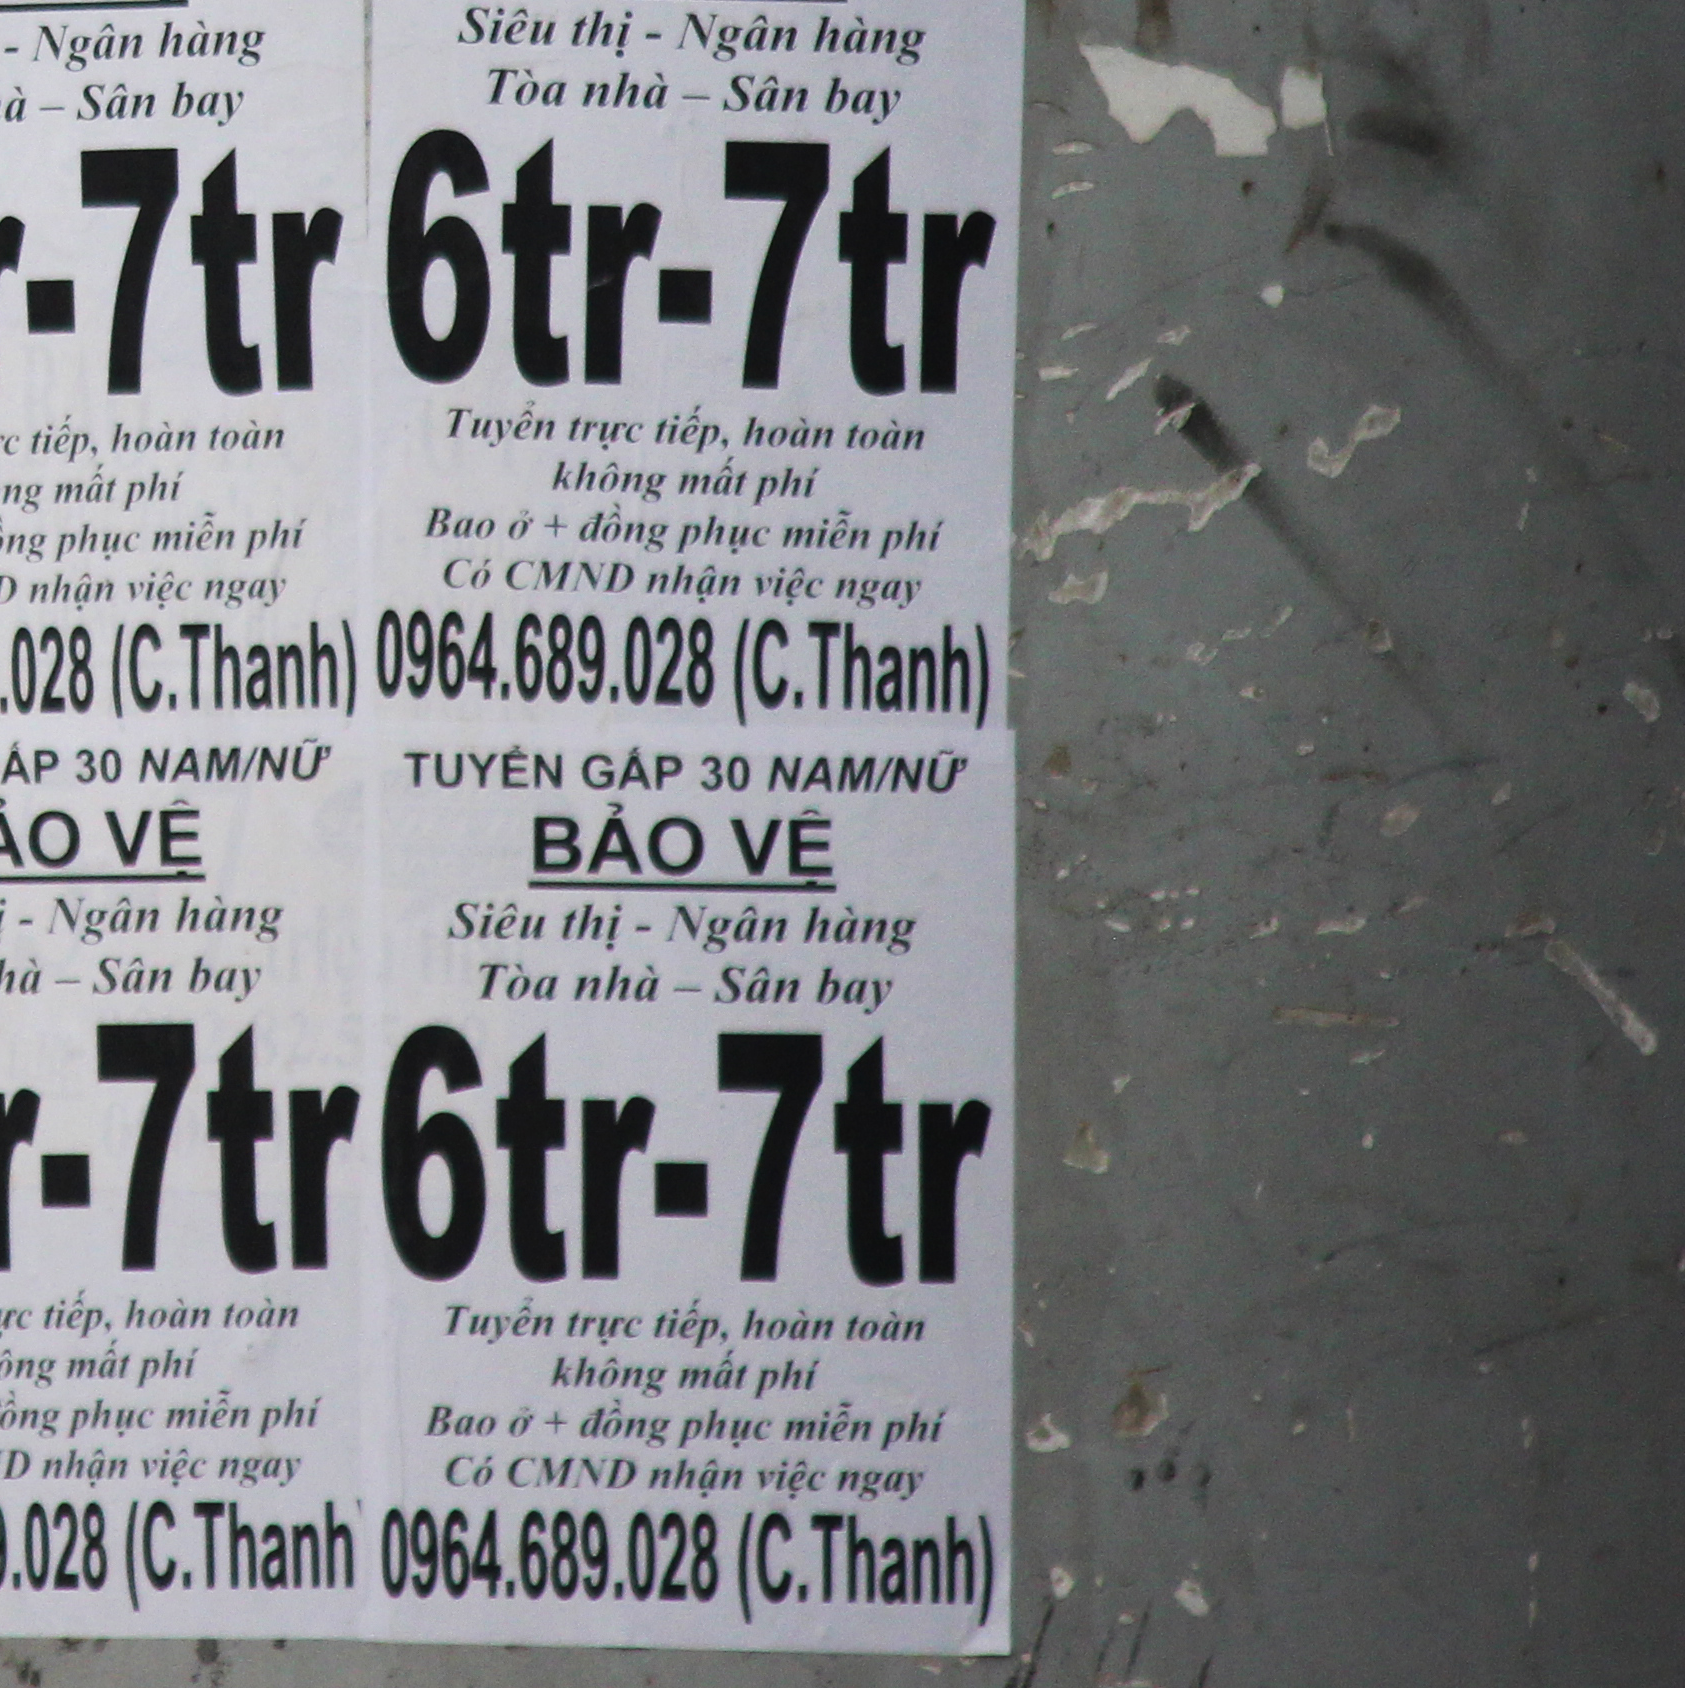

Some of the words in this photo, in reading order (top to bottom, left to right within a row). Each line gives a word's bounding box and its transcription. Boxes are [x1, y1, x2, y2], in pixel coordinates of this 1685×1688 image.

[387, 129, 997, 397] 6tr-7tr
[111, 619, 357, 719] (C.Thanh)
[376, 608, 715, 708] 0964.689.028
[733, 617, 991, 731] (C.Thanh)
[75, 748, 122, 784] 30
[139, 738, 332, 783] NAM/NỮ
[403, 745, 563, 789] TUYỂN
[581, 746, 684, 791] GẤP
[700, 754, 751, 792] 30
[767, 749, 969, 794] NAM/NỮ
[104, 799, 203, 874] VỆ
[533, 802, 705, 877] BẢO
[730, 808, 834, 885] VỆ
[382, 1025, 992, 1287] 6tr-7tr
[125, 1499, 361, 1608] (C.Thanh
[381, 1507, 720, 1603] 0964.689.028
[737, 1511, 996, 1628] (C.Thanh)
